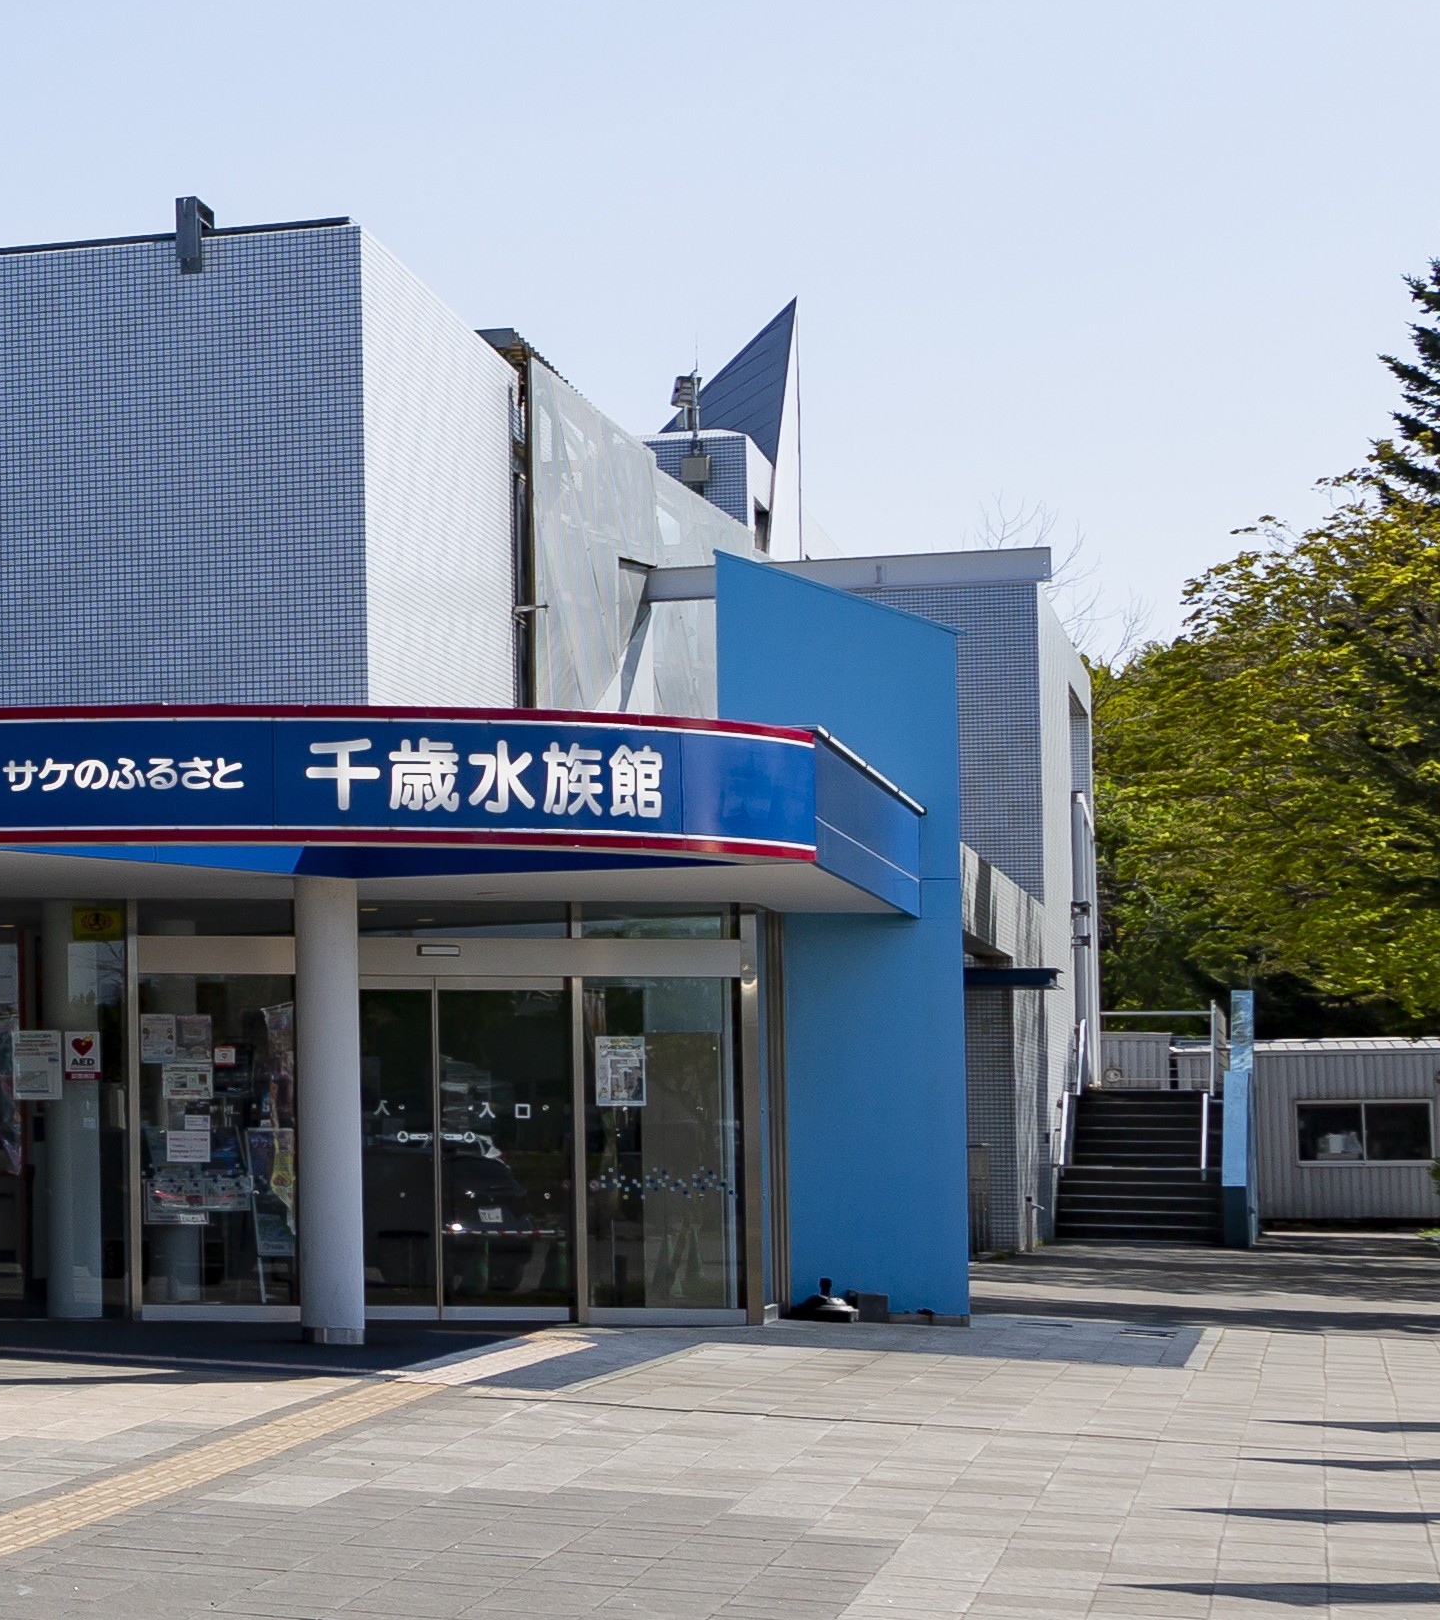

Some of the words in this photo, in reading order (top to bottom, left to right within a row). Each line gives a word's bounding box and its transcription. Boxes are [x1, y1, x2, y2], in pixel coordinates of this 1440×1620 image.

[2, 756, 244, 794] サケのふるさと
[305, 737, 664, 819] 千歳水族館
[70, 1057, 95, 1067] AED
[478, 1101, 531, 1119] 入口
